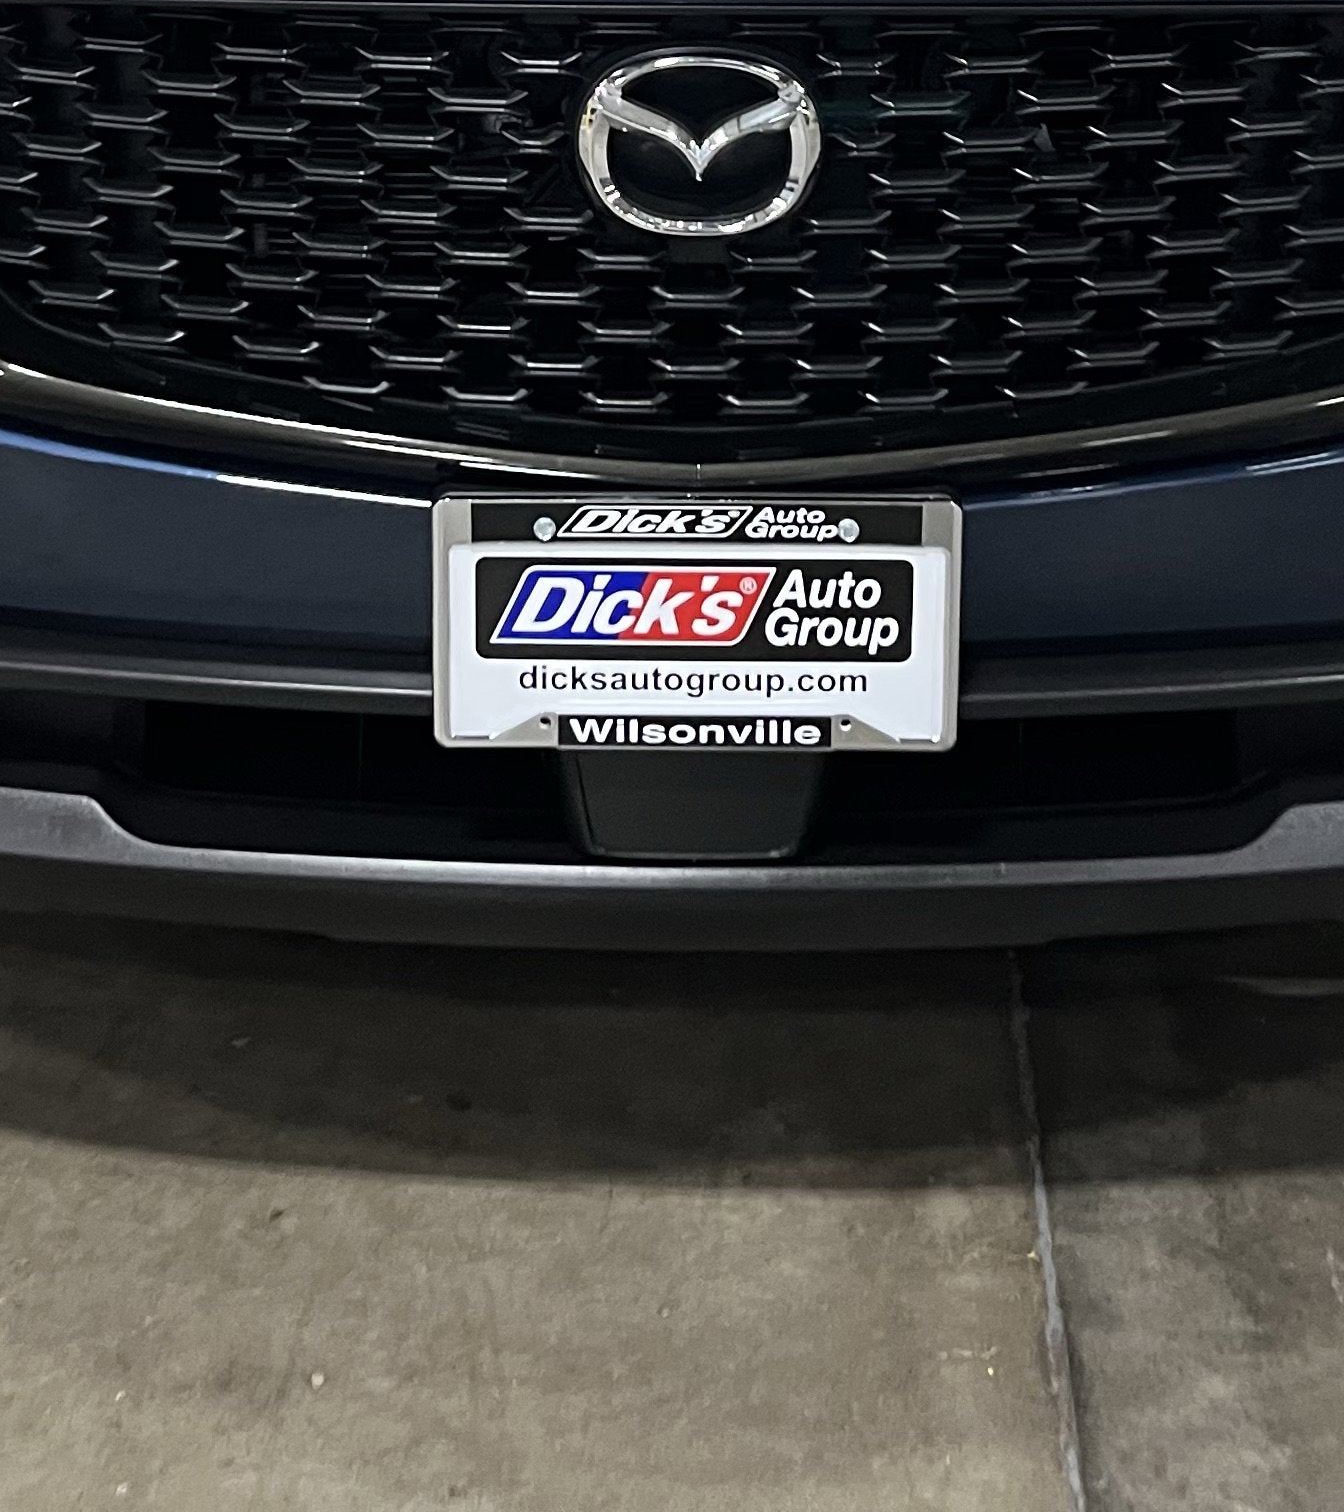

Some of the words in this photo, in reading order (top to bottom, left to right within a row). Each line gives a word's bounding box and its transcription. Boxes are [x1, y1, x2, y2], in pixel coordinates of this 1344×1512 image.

[571, 508, 731, 533] Dick's
[757, 506, 826, 524] Auto
[744, 522, 839, 542] Group
[772, 569, 882, 609] Auto
[511, 574, 744, 636] Dick's
[765, 607, 900, 655] Group
[519, 665, 868, 698] dicksautogroup.com
[569, 718, 822, 745] Wilsonville
